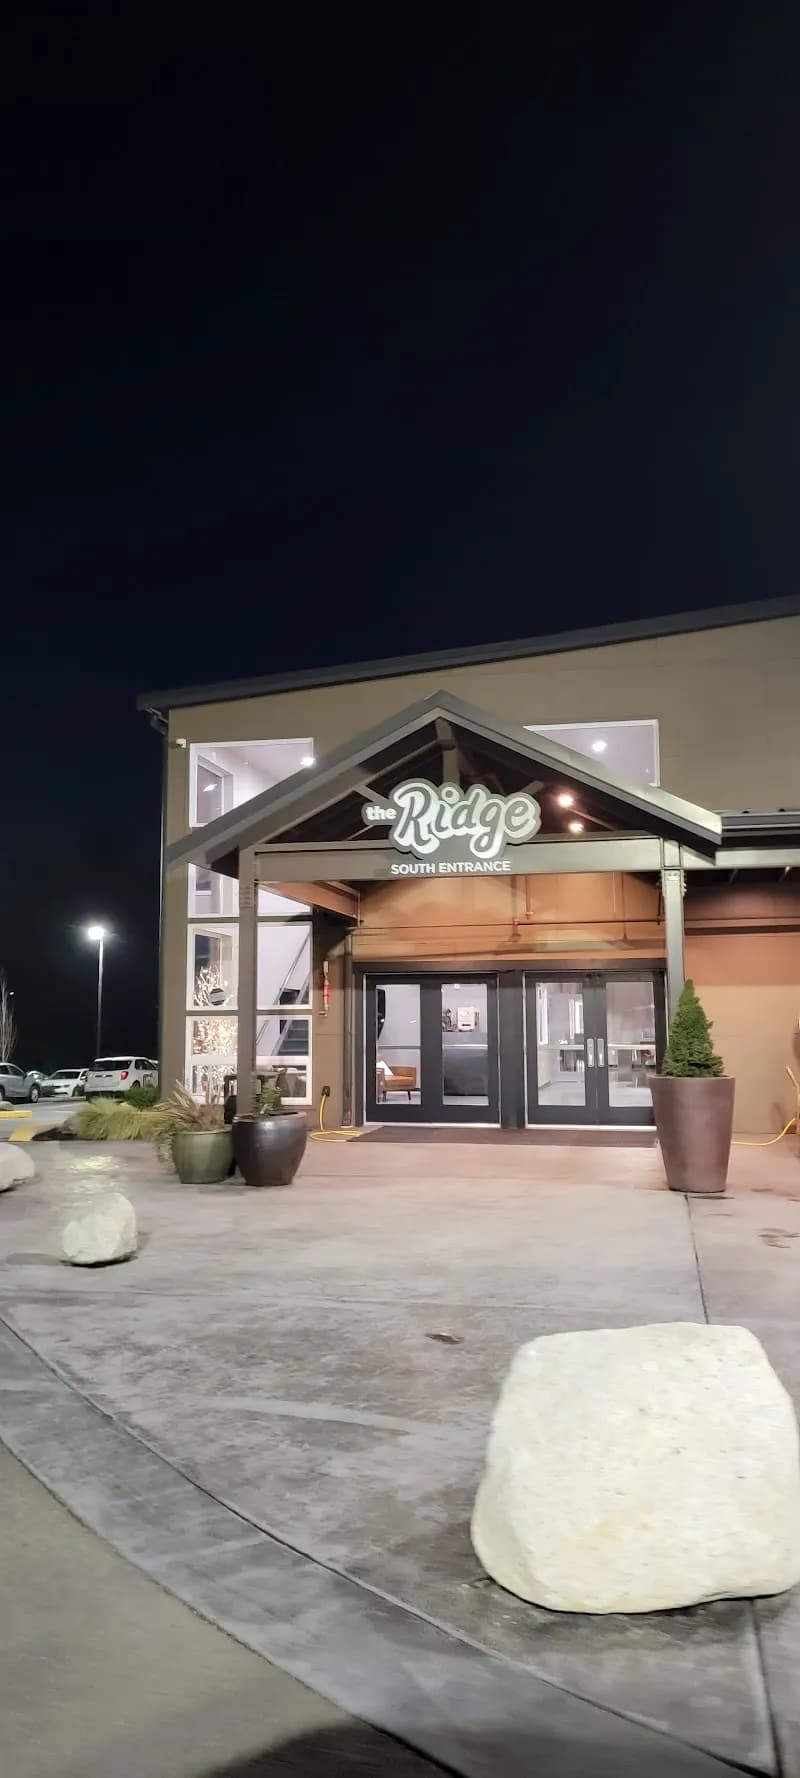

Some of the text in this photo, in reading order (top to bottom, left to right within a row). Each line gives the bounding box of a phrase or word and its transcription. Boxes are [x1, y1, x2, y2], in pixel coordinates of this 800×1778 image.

[366, 783, 537, 859] the Ridge
[391, 861, 511, 875] SOUTH ENTRANCE
